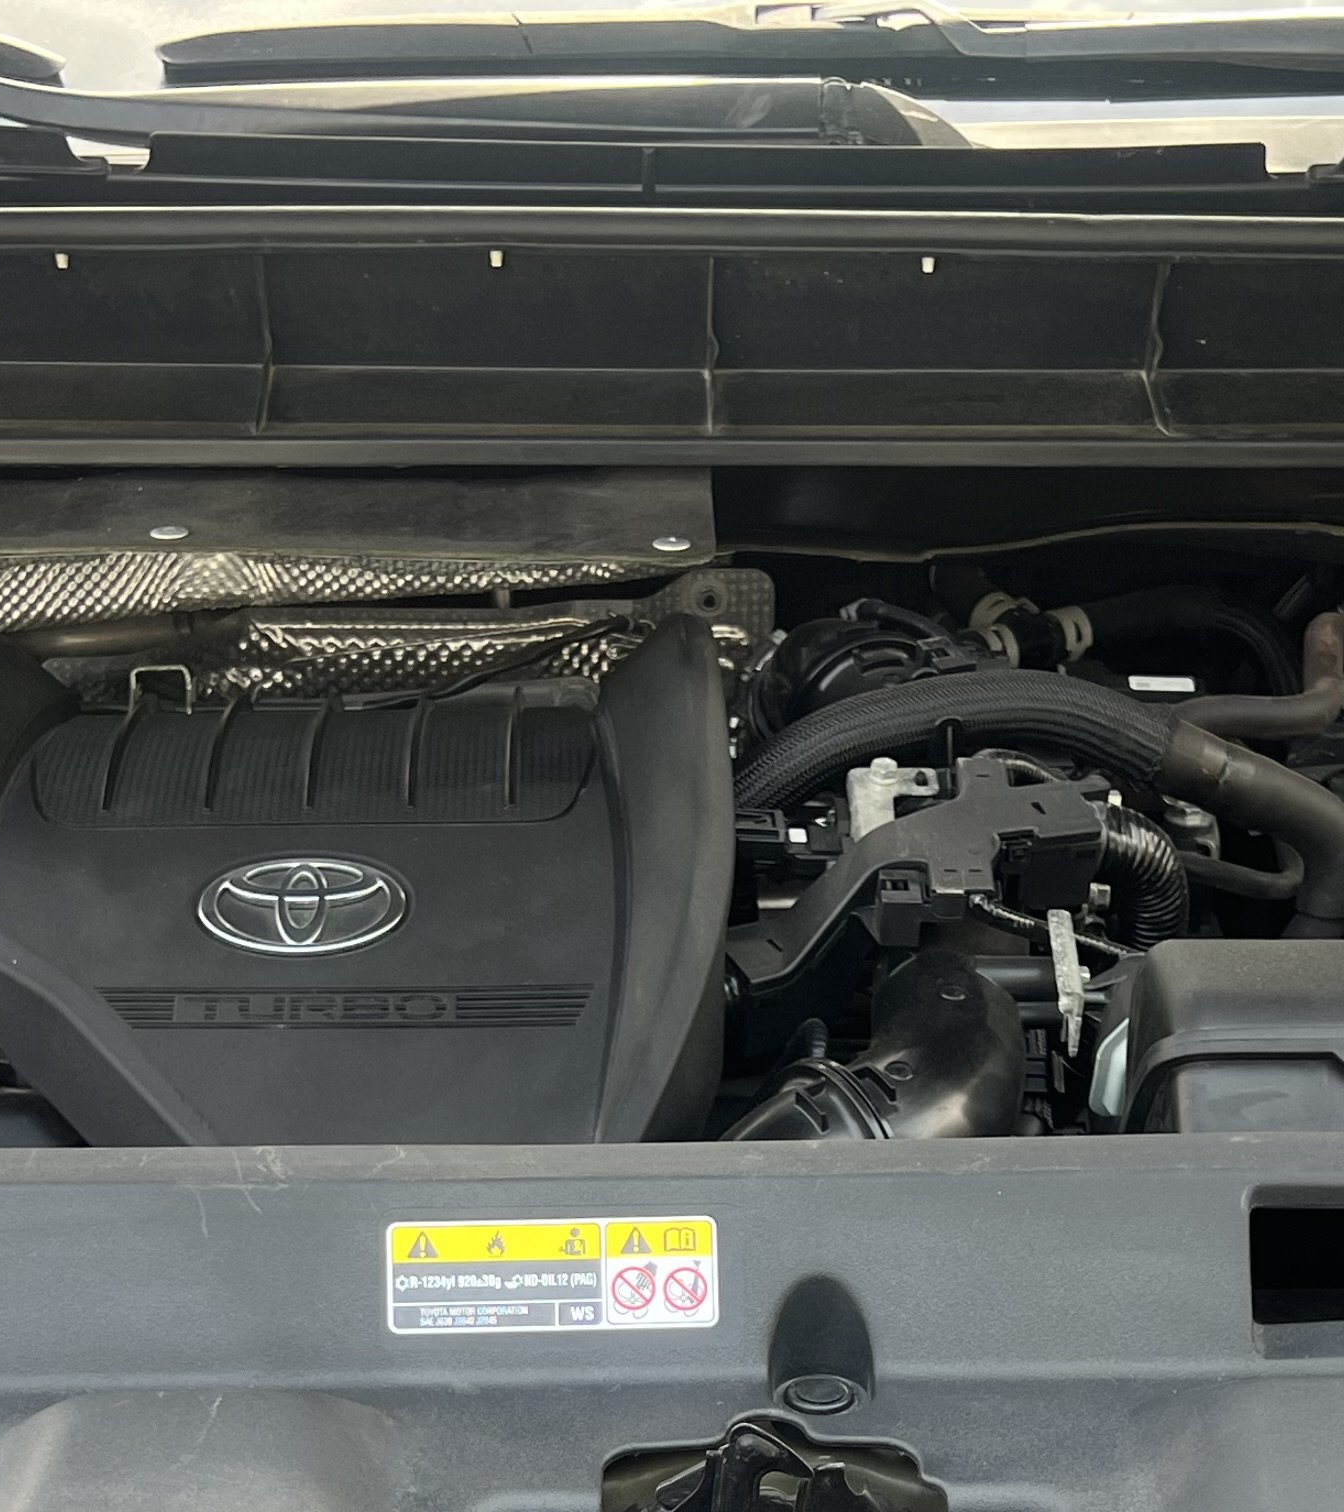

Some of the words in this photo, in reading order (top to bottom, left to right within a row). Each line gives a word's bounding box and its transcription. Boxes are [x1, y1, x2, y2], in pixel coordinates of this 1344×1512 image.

[181, 994, 448, 1021] TURBO
[570, 1272, 597, 1289] (PAG)
[419, 1307, 448, 1317] TOYOTA
[476, 1305, 529, 1315] CORPORATION
[570, 1305, 595, 1321] WS
